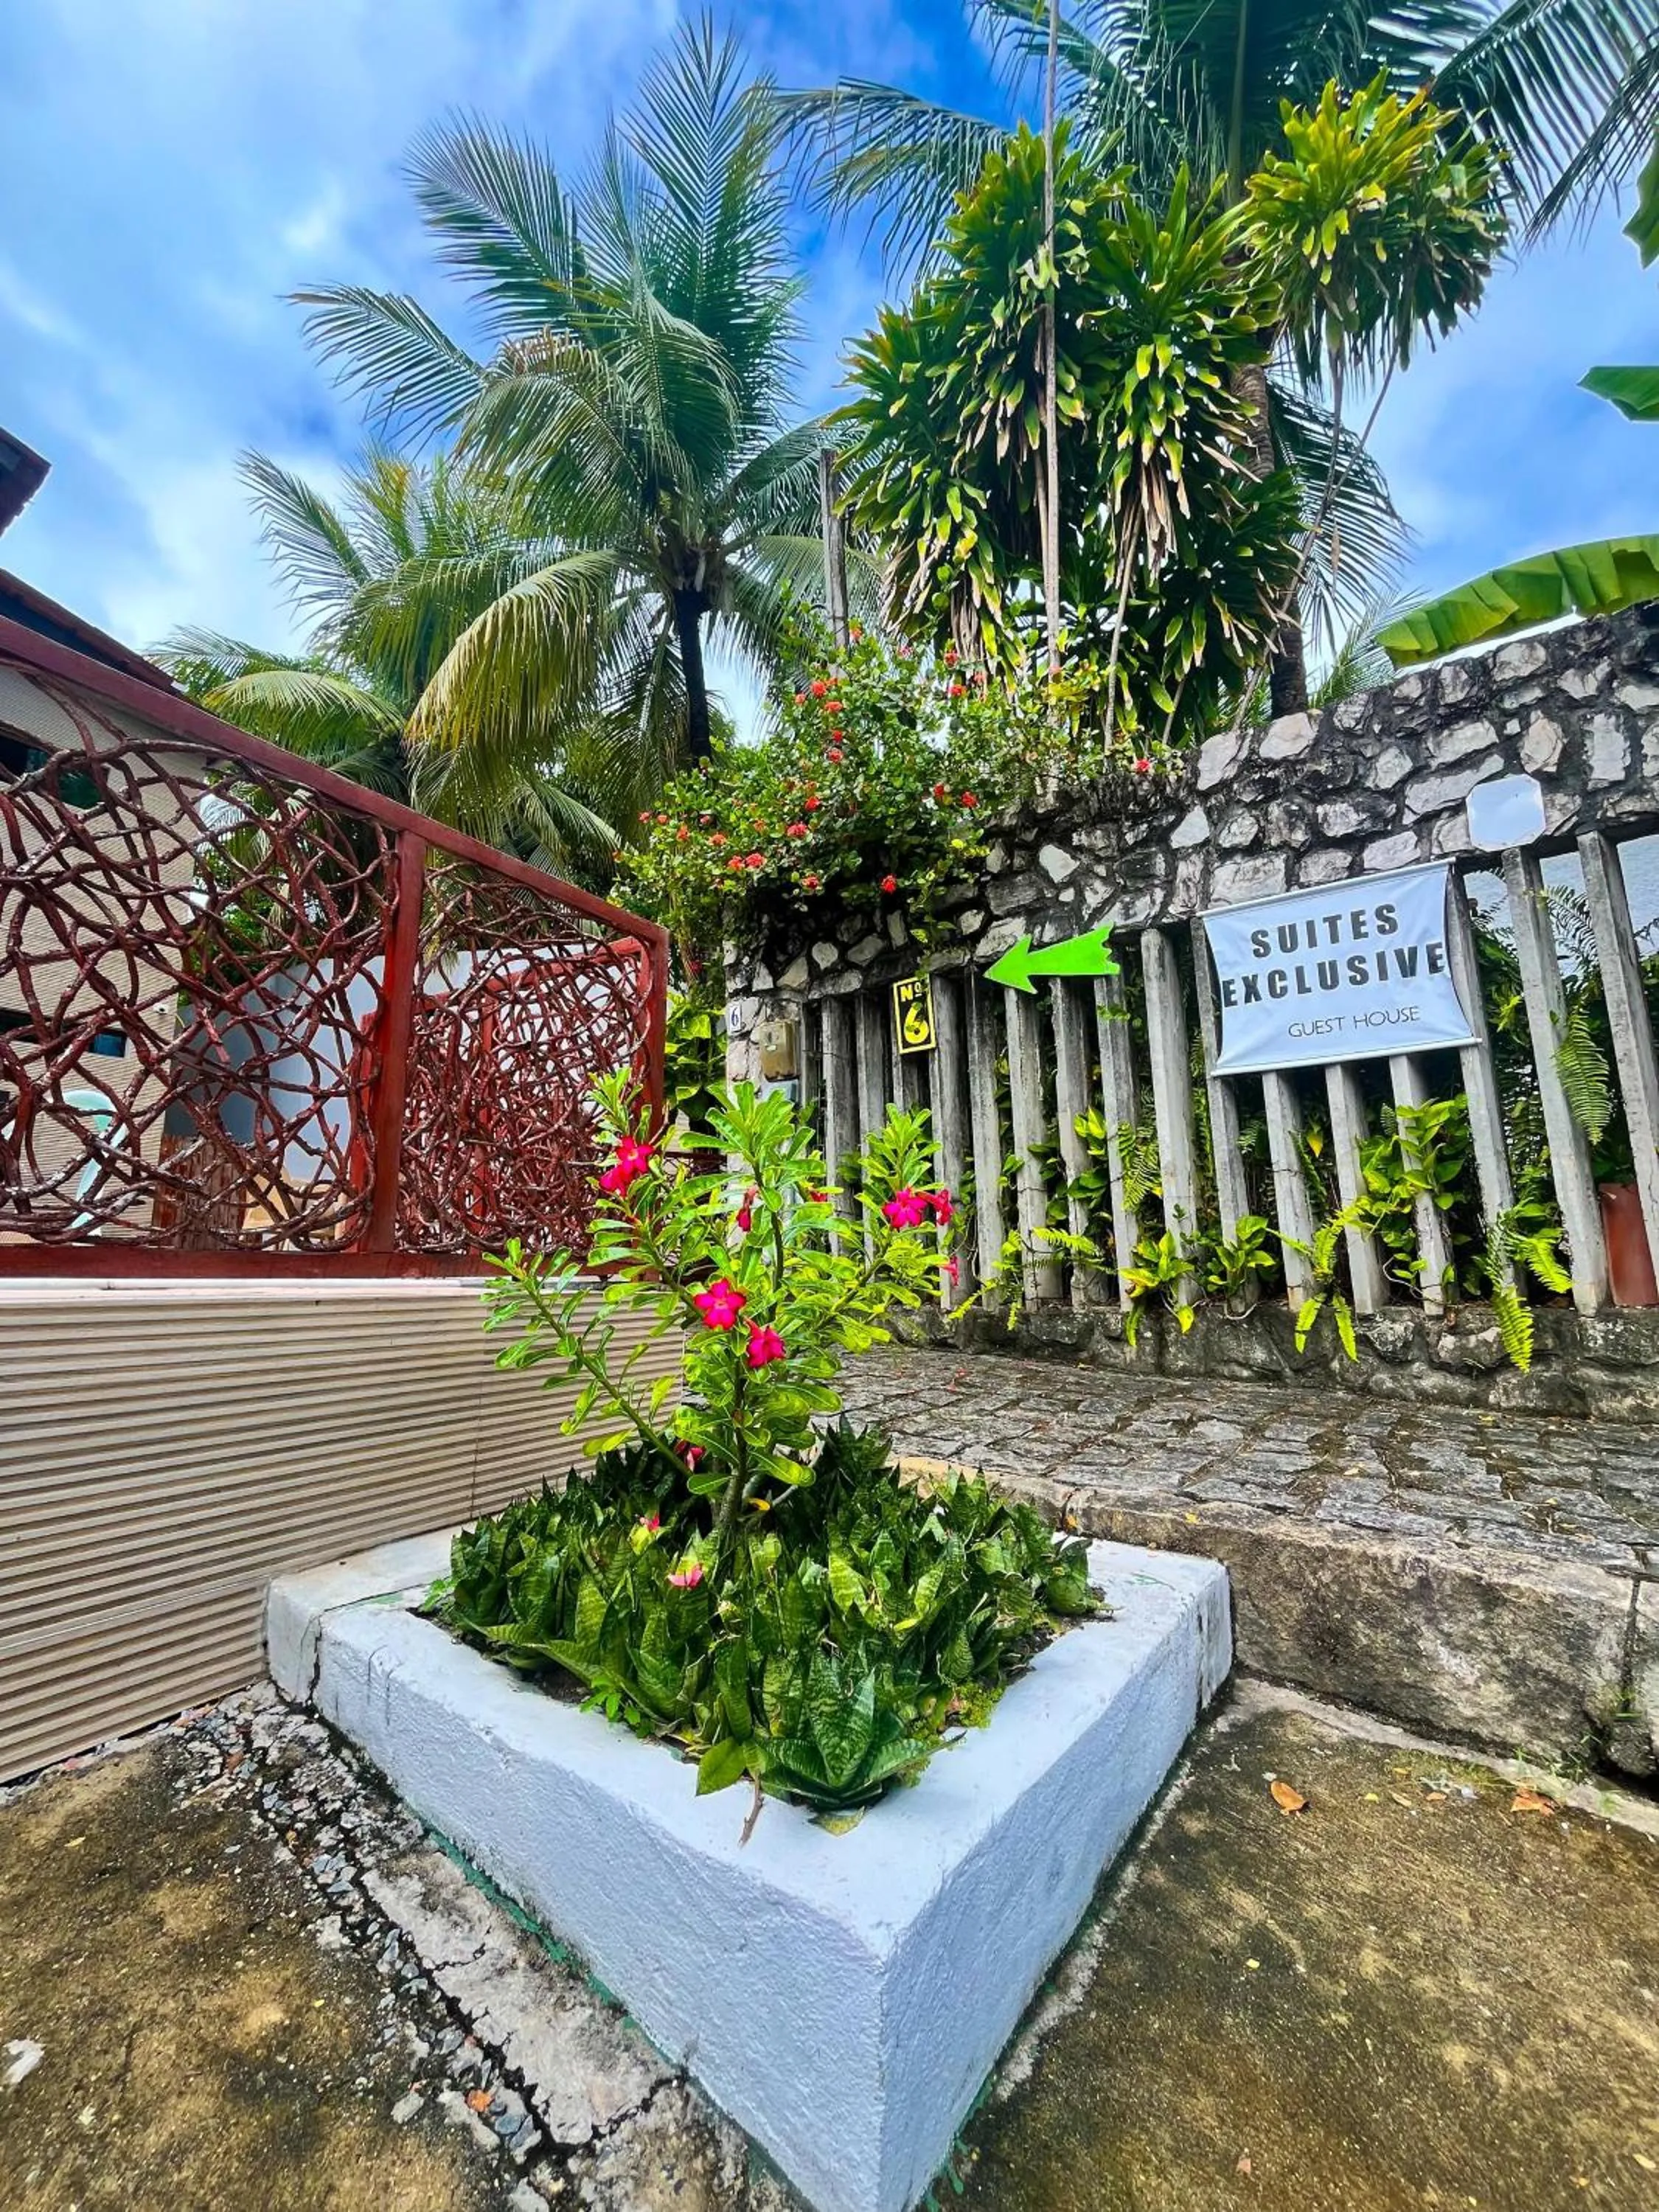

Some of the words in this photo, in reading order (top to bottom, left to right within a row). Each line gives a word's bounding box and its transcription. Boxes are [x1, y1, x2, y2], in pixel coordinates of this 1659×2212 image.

[1251, 904, 1398, 958] SUITES
[1222, 942, 1445, 1007] EXCLUSIVE
[731, 1007, 739, 1026] 6
[903, 1002, 929, 1044] 6
[1288, 1015, 1346, 1037] GUEST
[1352, 1006, 1422, 1029] HOUSE
